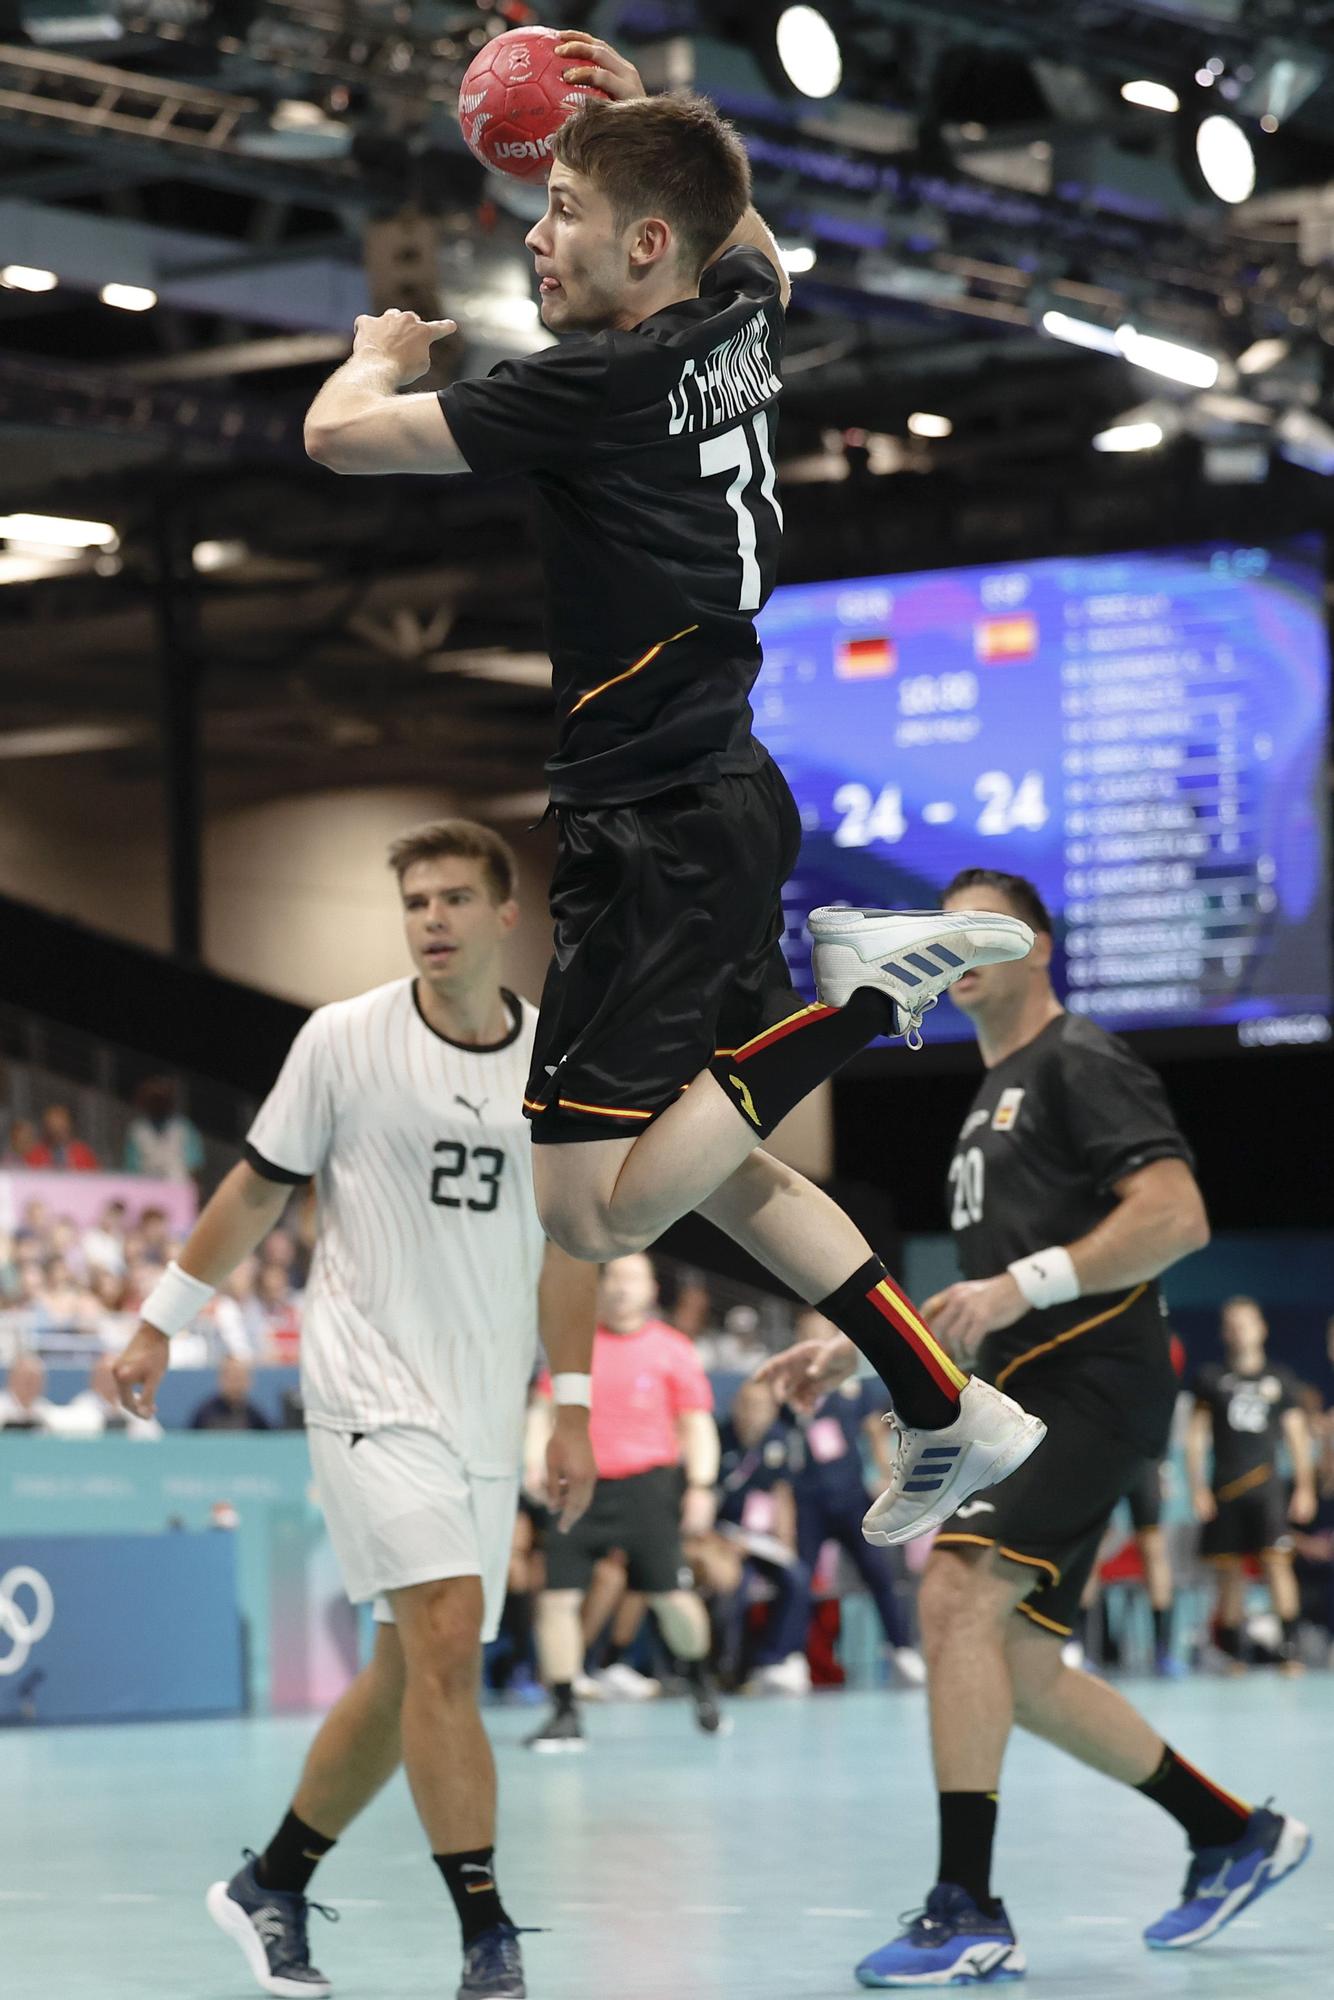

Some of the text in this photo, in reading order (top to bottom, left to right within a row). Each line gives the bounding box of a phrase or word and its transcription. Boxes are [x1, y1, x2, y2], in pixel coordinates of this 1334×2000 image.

[494, 134, 554, 160] olten
[833, 781, 907, 847] 24
[975, 770, 1049, 835] 24
[432, 1140, 504, 1212] 23
[948, 1147, 984, 1231] 20
